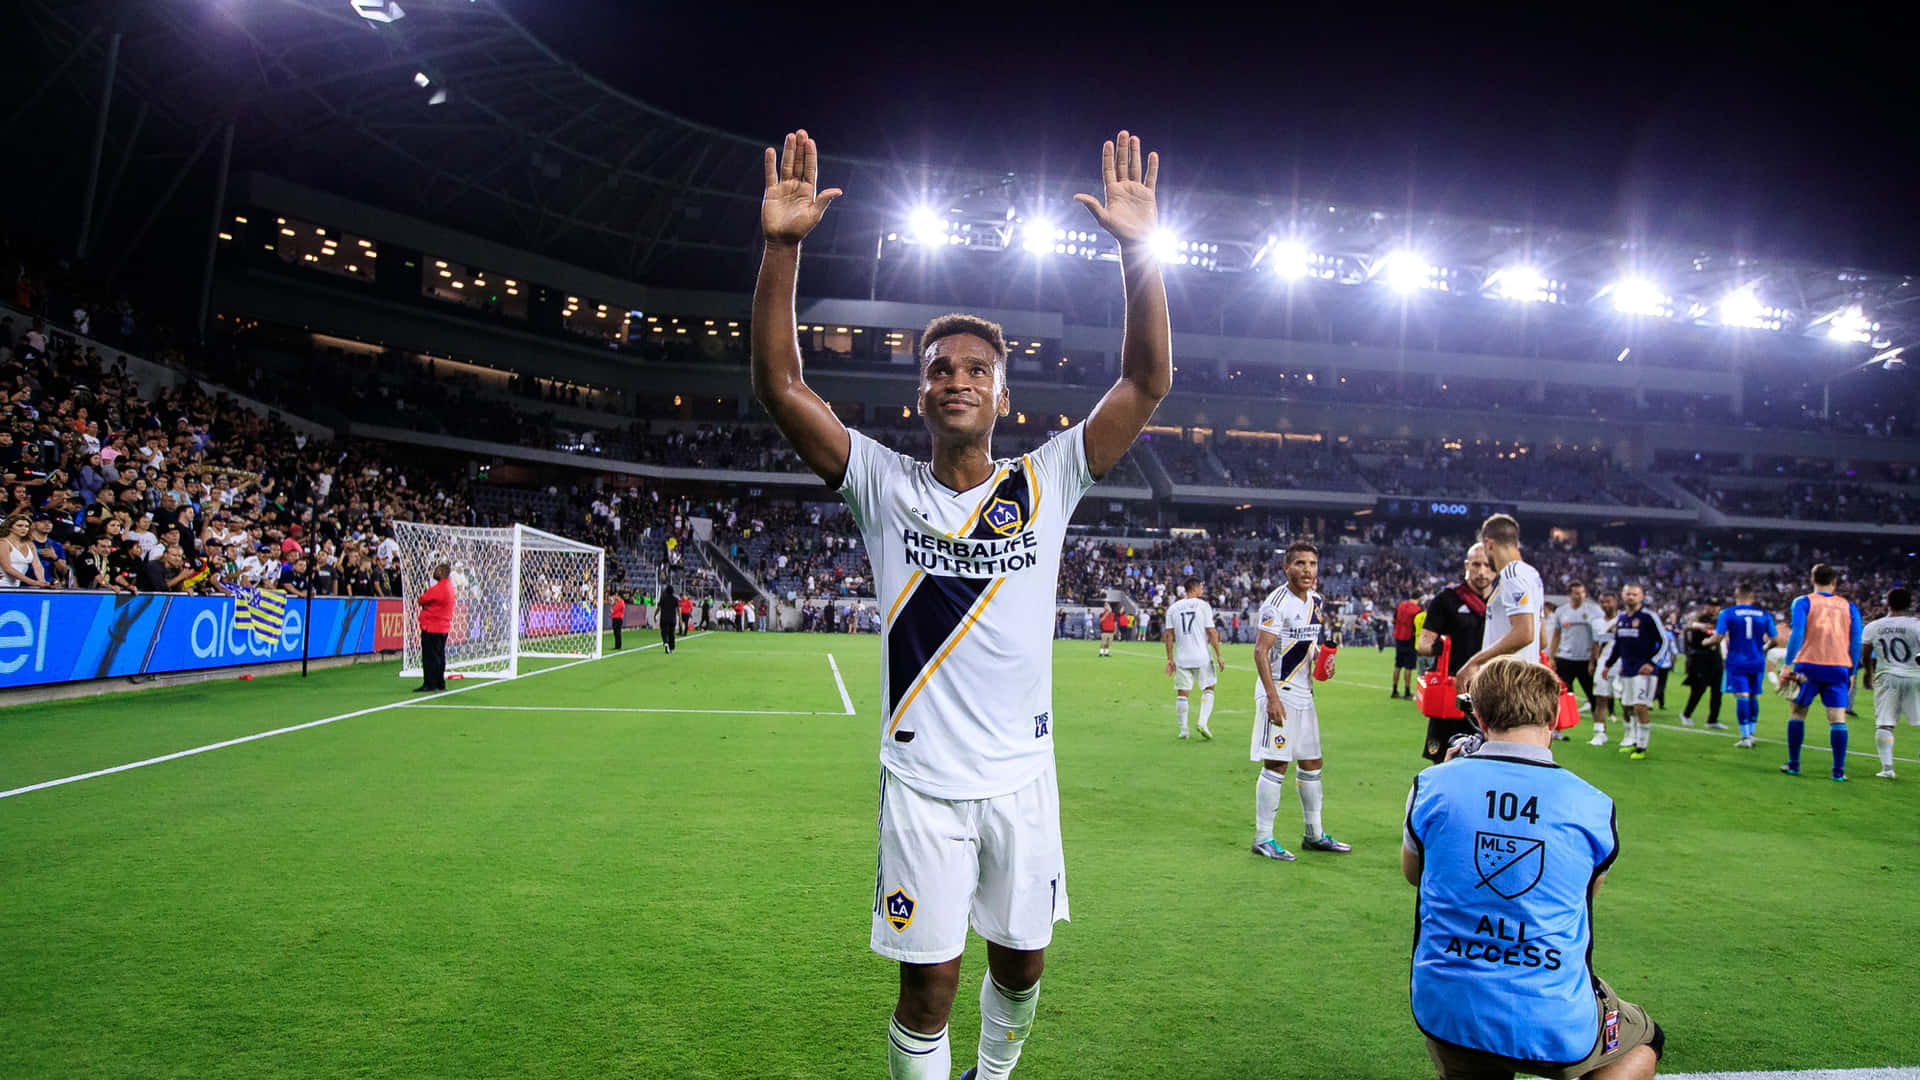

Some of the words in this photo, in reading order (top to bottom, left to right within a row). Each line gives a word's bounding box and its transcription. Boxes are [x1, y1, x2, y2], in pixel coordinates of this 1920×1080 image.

[994, 511, 1015, 525] LA
[903, 529, 1037, 558] HERBALIFE
[905, 548, 1036, 575] NUTRITION
[1180, 611, 1196, 633] 17
[1744, 615, 1753, 640] 1
[1878, 637, 1912, 664] 10
[1035, 722, 1049, 739] LA
[1485, 790, 1540, 825] 104
[1481, 836, 1517, 853] MLS
[891, 902, 909, 917] LA
[1475, 915, 1529, 942] ALL
[1444, 937, 1562, 970] ACCESS
